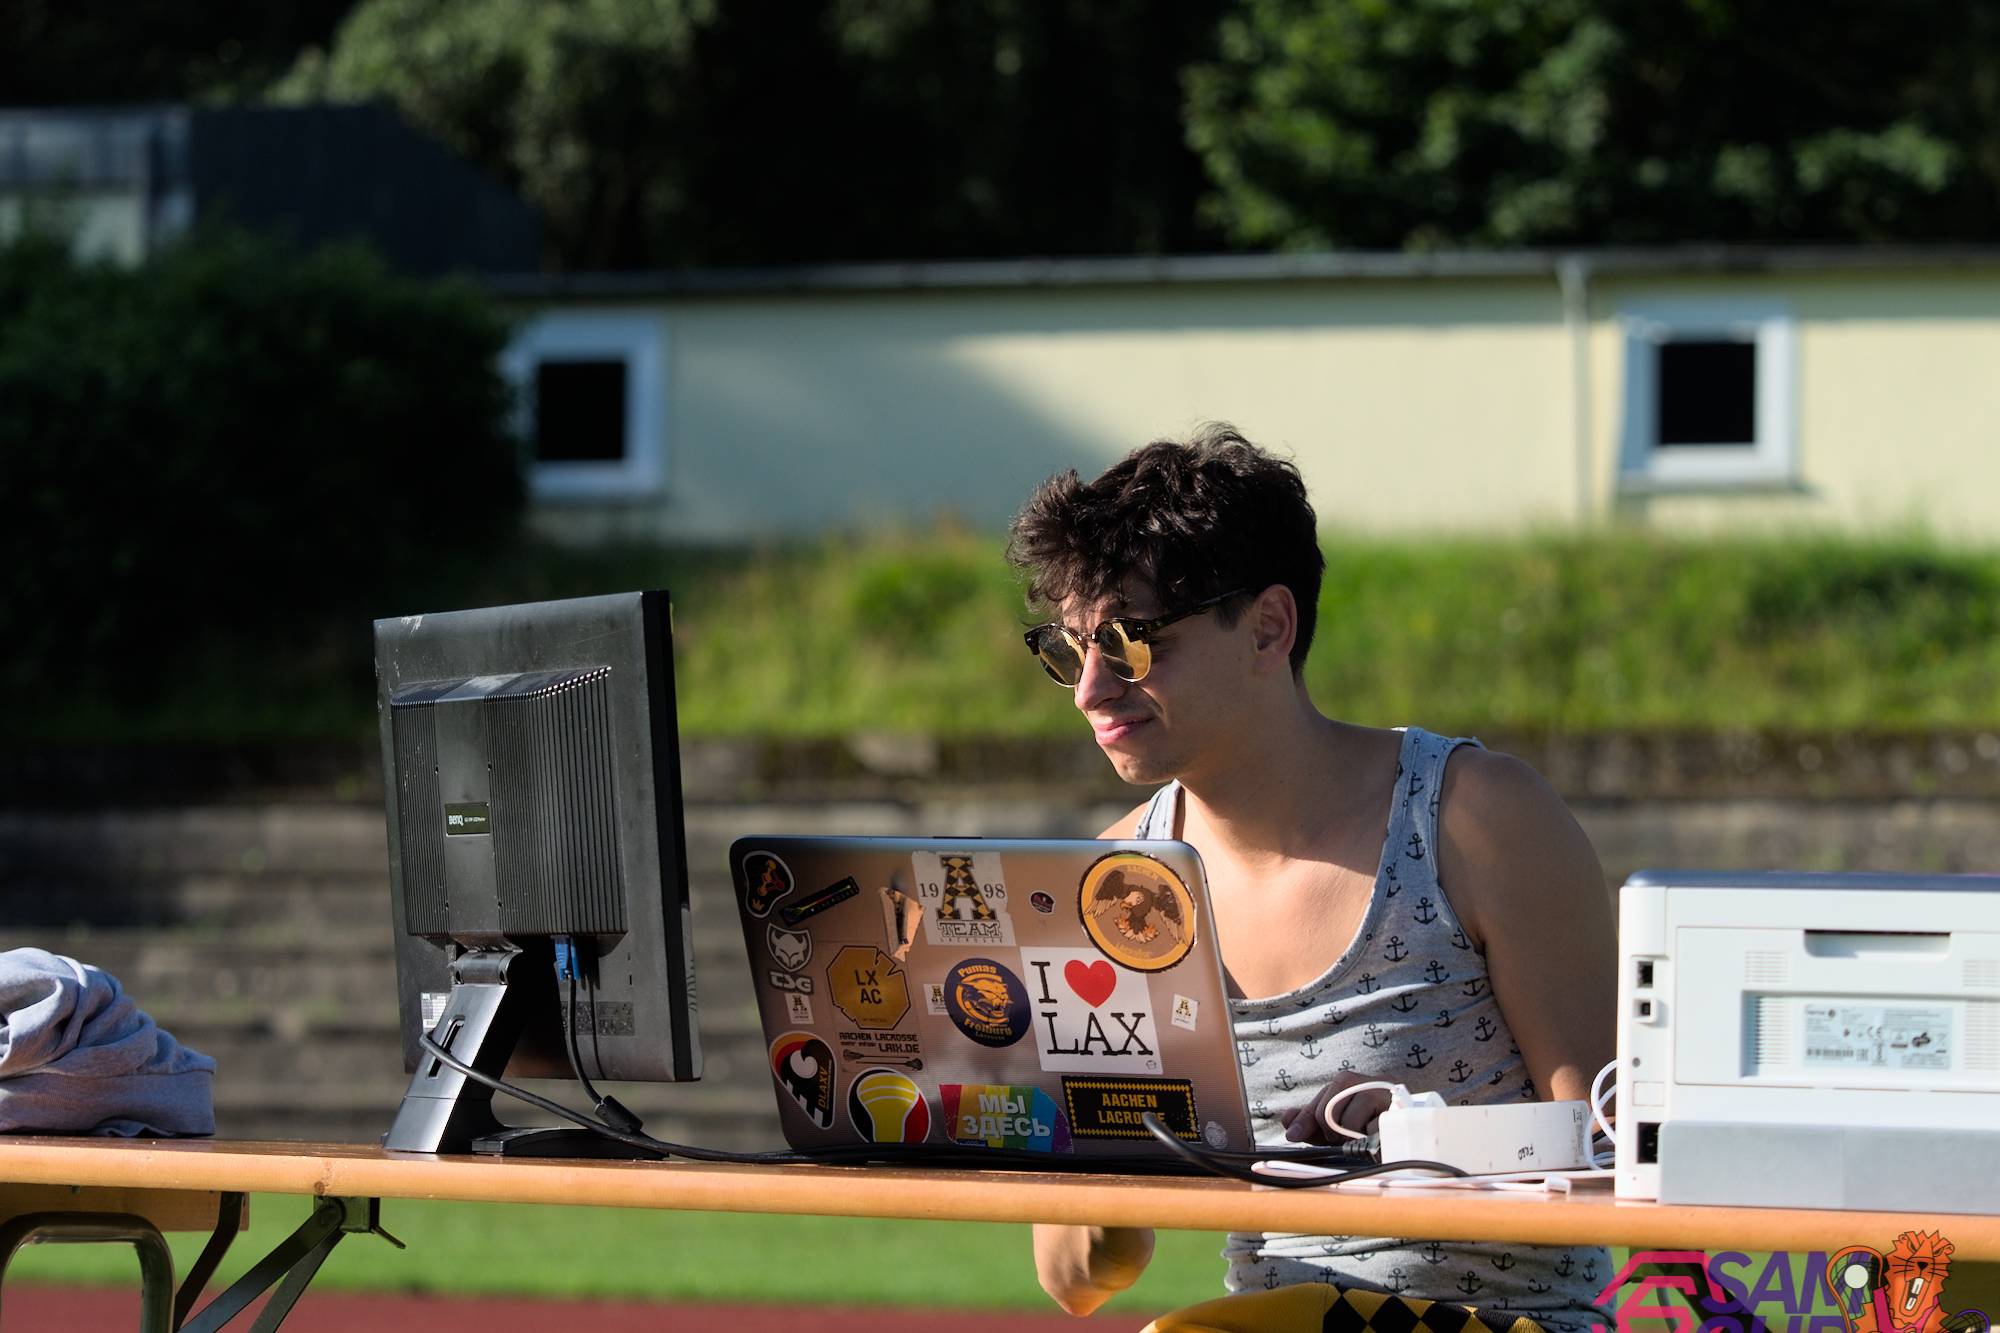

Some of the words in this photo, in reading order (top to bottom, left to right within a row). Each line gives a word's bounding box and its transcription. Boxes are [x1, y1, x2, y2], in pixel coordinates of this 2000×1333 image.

[919, 882, 940, 898] 19
[983, 883, 1007, 899] 98
[939, 922, 1000, 937] TEAM
[854, 968, 880, 987] LX
[958, 964, 997, 977] Pumas
[1030, 961, 1058, 1004] I
[860, 987, 883, 1005] AC
[839, 1032, 872, 1041] AACHEN
[874, 1033, 918, 1042] LACROSSE
[1041, 1012, 1154, 1056] LAX
[818, 1067, 830, 1109] DLAXV
[978, 1094, 1027, 1115] МЫ
[1102, 1093, 1158, 1108] AACHEN
[1097, 1110, 1166, 1125] LACROE
[962, 1115, 1051, 1139] ЗДЕСЬ
